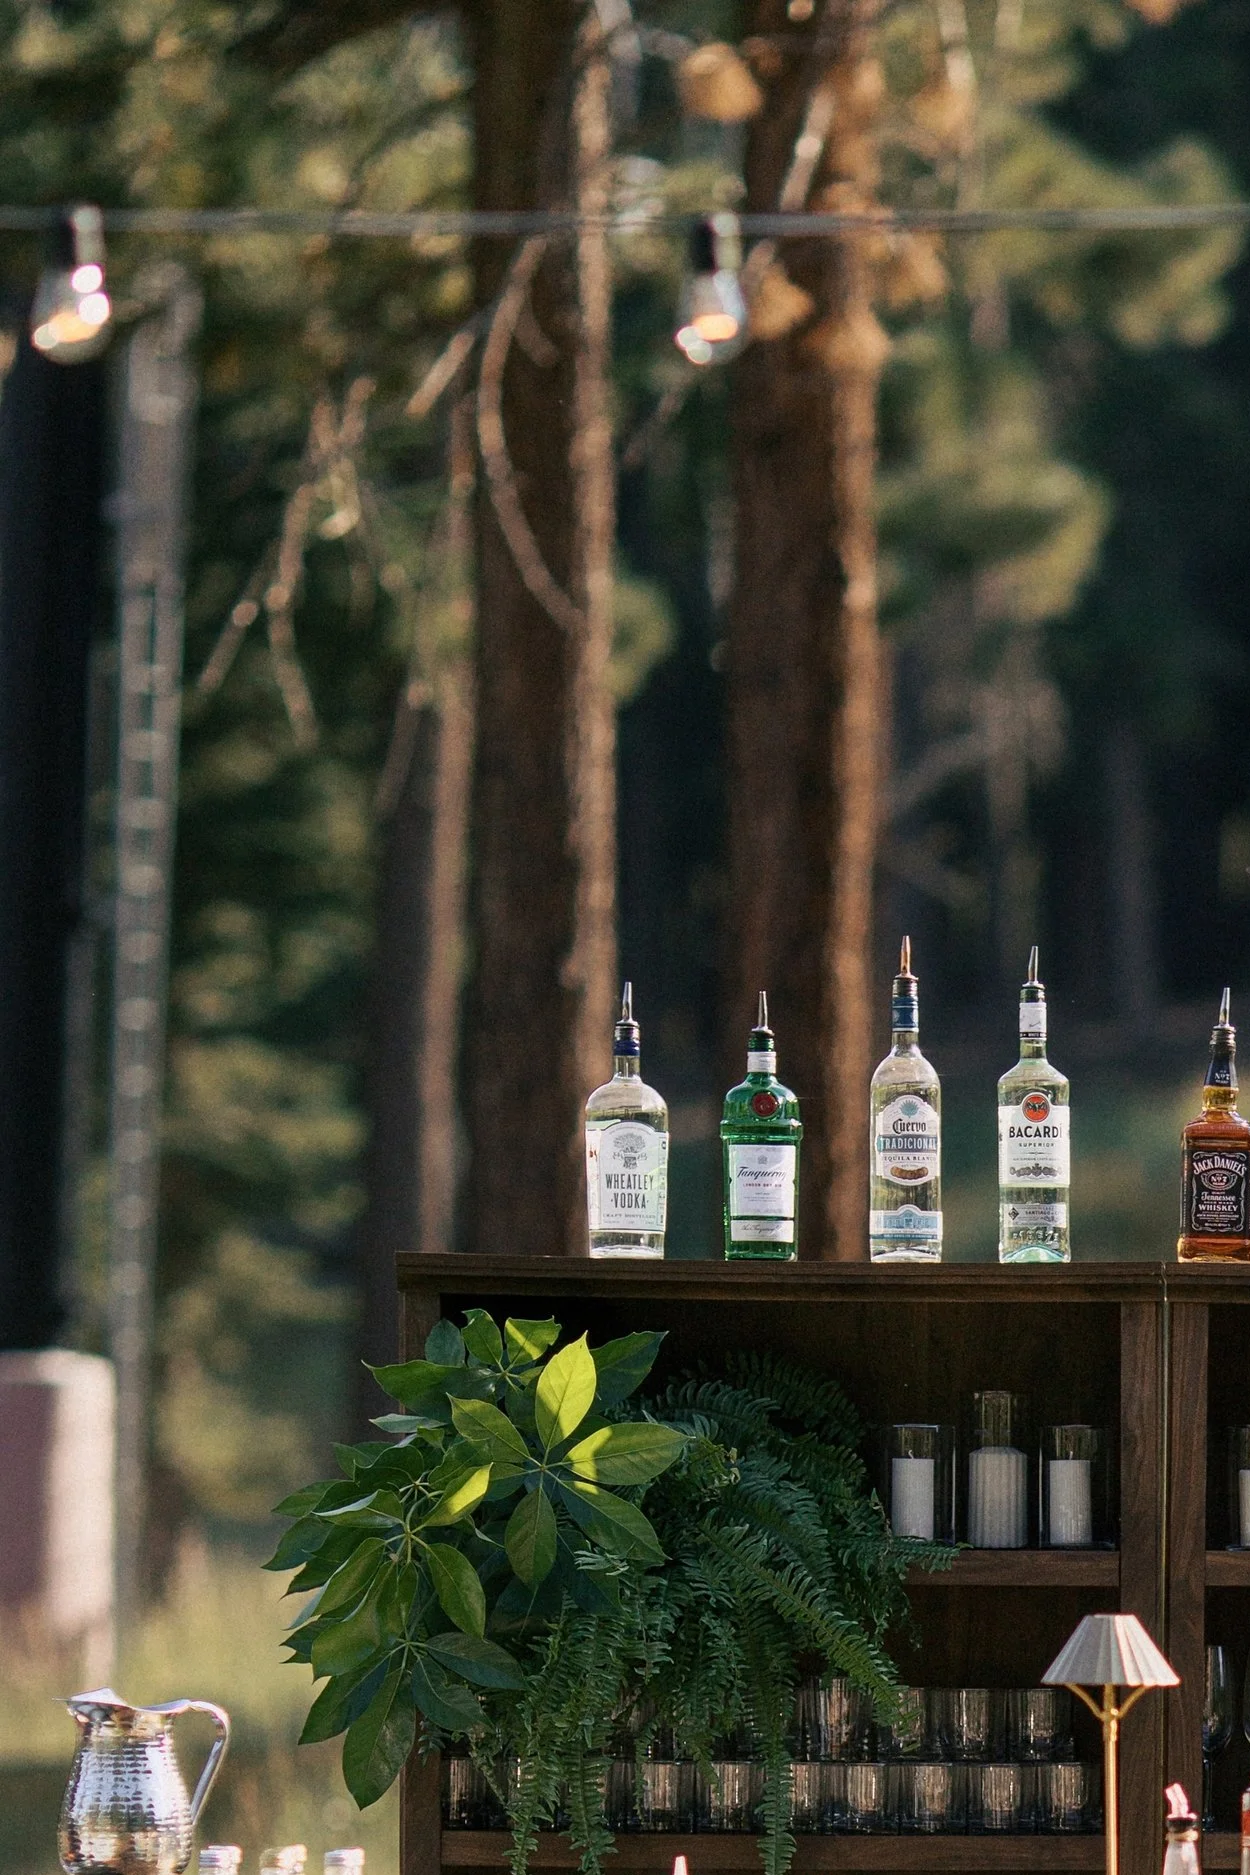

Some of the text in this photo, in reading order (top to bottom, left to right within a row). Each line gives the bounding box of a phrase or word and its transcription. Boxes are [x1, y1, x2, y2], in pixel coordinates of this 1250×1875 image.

[892, 1118, 927, 1135] Cuervo
[880, 1137, 937, 1150] TRADICIONAL
[1192, 1155, 1248, 1178] JACK DANIEL'S
[605, 1174, 654, 1190] WHEATLEY
[1200, 1191, 1237, 1202] Tennessee
[1197, 1204, 1239, 1212] WHISKEY
